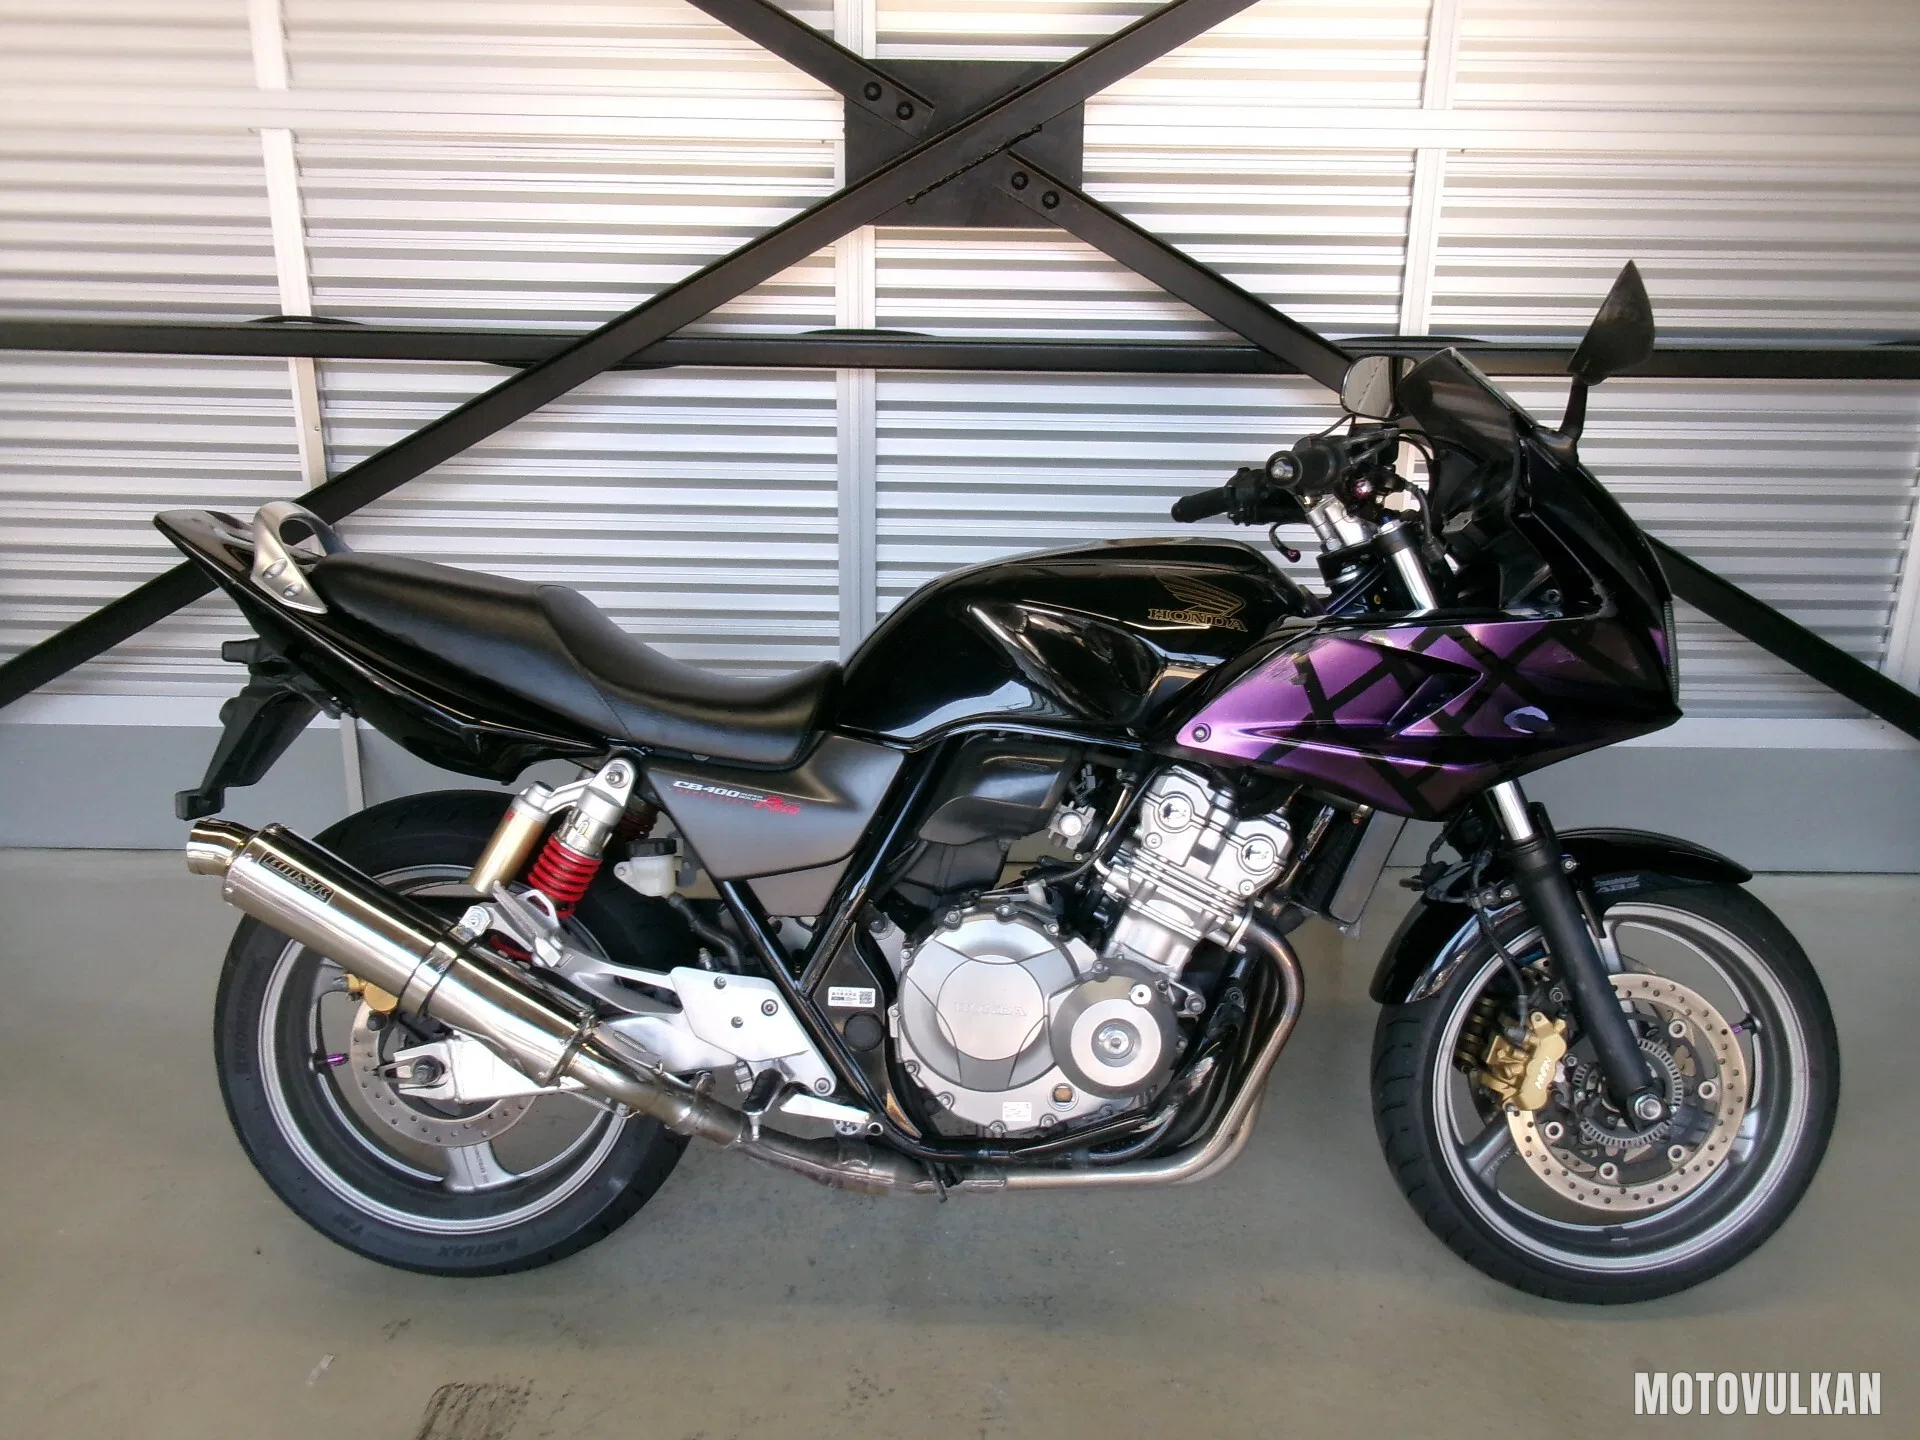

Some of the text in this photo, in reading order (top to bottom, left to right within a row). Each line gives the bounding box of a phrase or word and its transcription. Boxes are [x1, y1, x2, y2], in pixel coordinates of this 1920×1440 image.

[1147, 608, 1248, 632] HONDA
[673, 780, 740, 797] CB400
[954, 1001, 1028, 1017] HONDA
